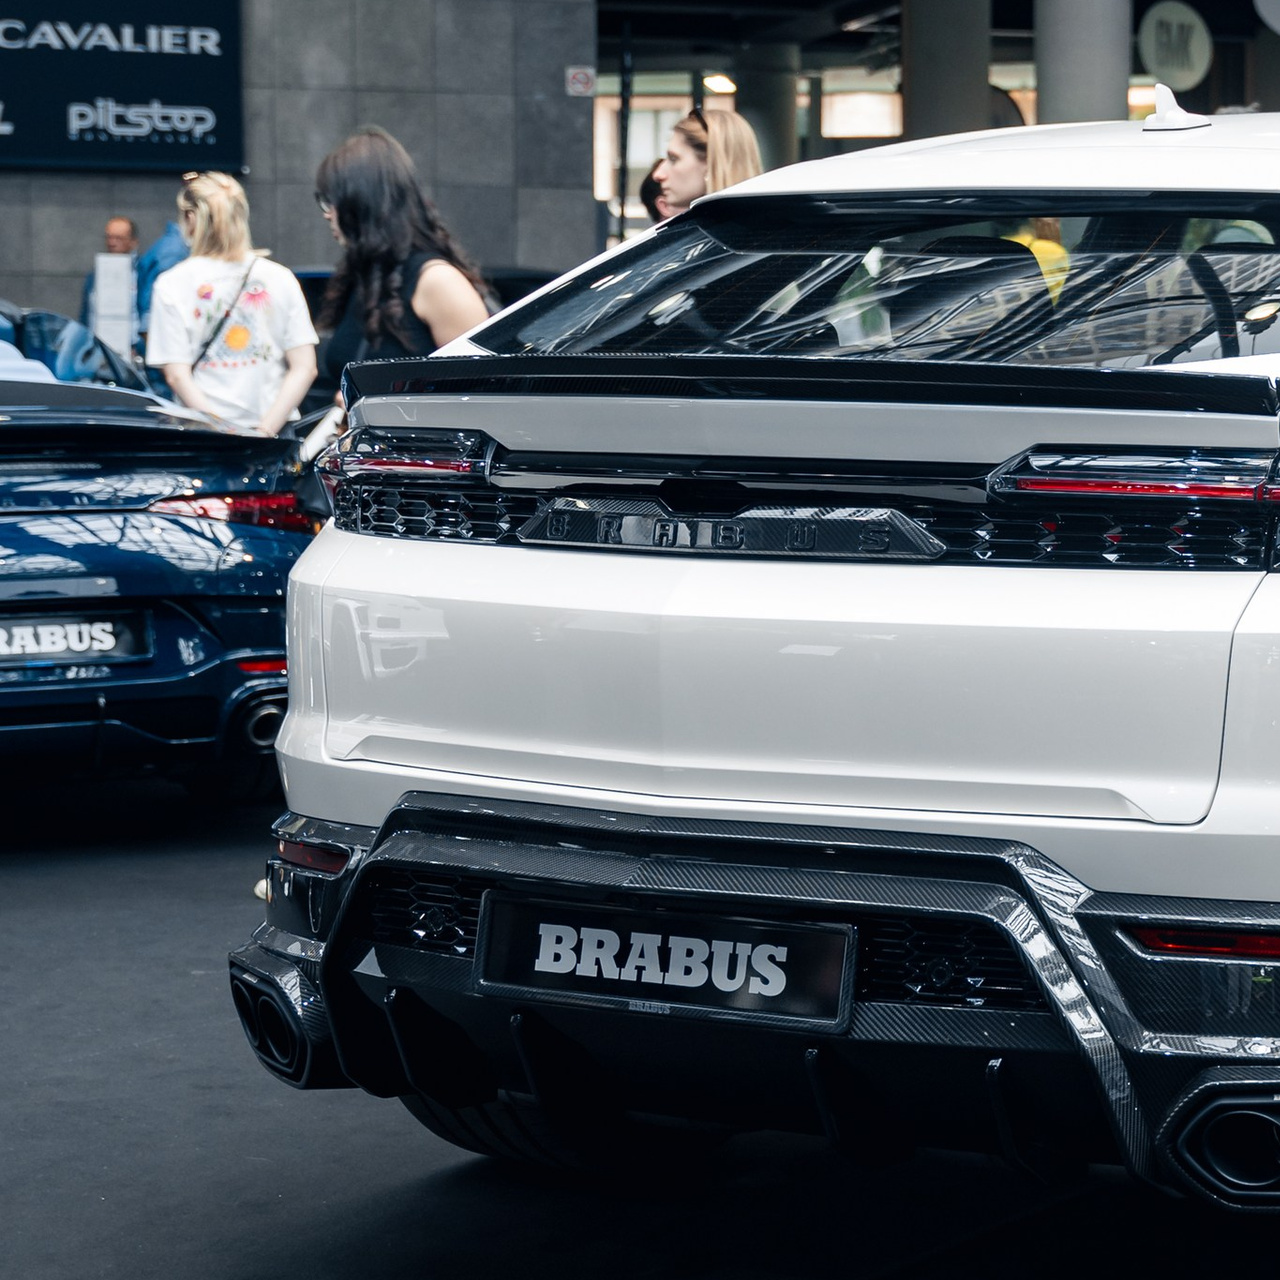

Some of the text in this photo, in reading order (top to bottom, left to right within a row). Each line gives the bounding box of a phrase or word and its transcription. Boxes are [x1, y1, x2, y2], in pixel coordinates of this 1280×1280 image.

[0, 19, 222, 56] CAVALIER
[67, 97, 216, 138] pitstop
[548, 513, 890, 552] BRABUS
[534, 922, 788, 998] BRABUS
[629, 1000, 671, 1015] BRABUS
